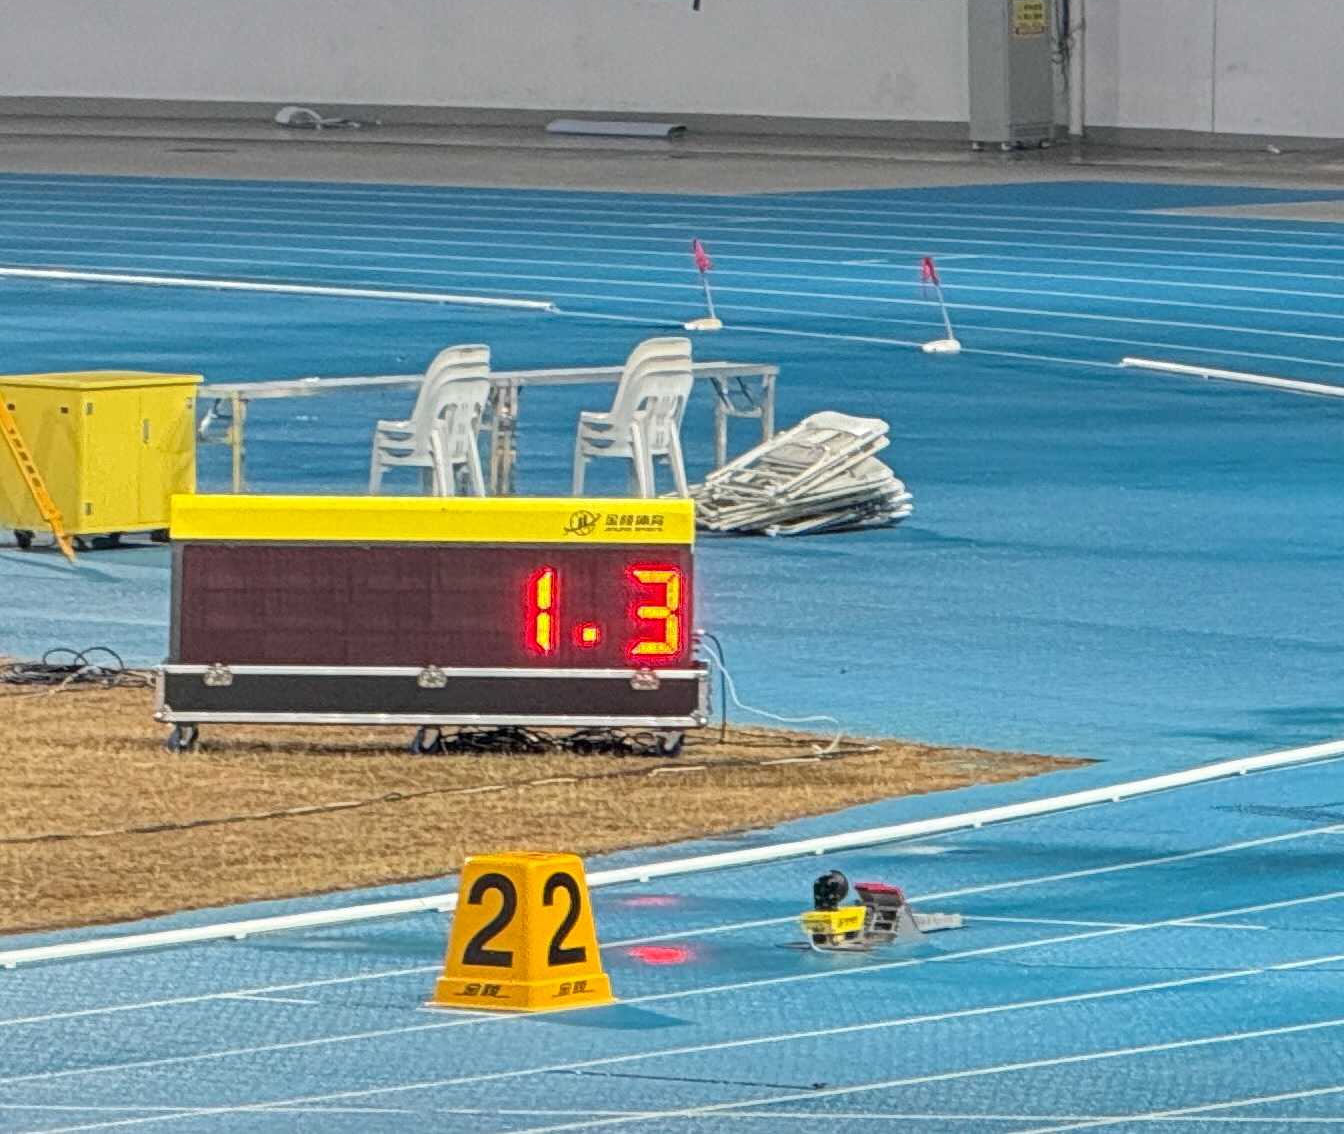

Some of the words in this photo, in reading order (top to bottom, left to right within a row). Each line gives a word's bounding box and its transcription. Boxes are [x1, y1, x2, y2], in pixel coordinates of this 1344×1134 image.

[535, 569, 681, 657] 1.3
[462, 872, 518, 968] 2
[543, 871, 588, 967] 2
